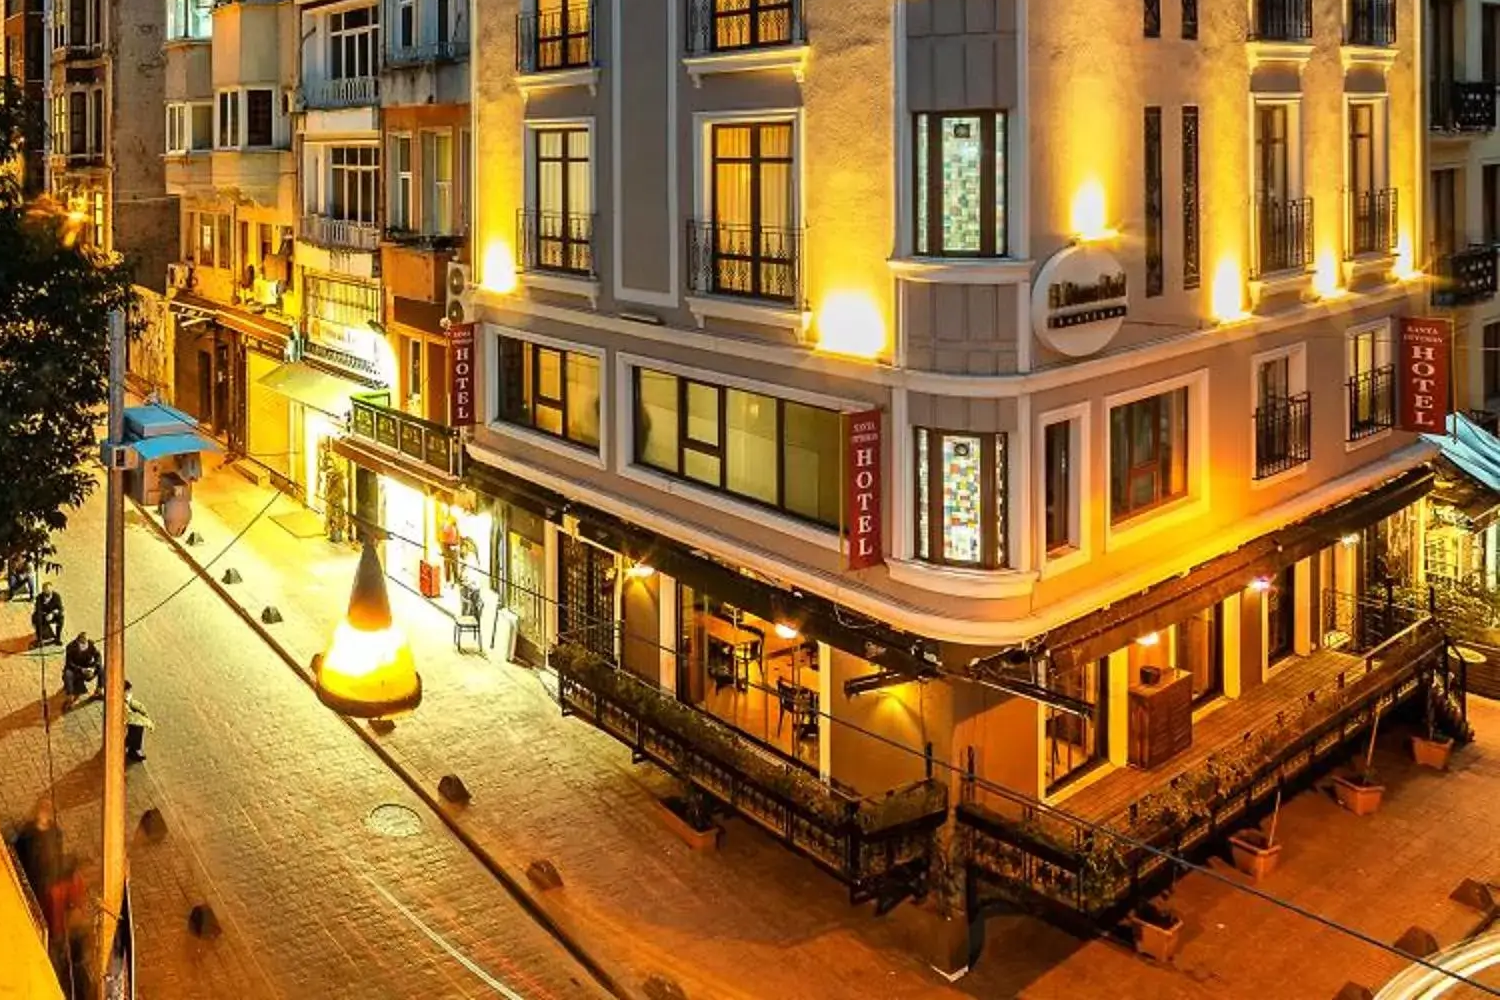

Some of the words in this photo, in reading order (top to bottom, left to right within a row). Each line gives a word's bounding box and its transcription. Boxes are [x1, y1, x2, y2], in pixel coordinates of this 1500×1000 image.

[455, 347, 469, 419] HOTEL
[1411, 345, 1436, 425] HOTEL
[856, 449, 873, 556] HOTEL
